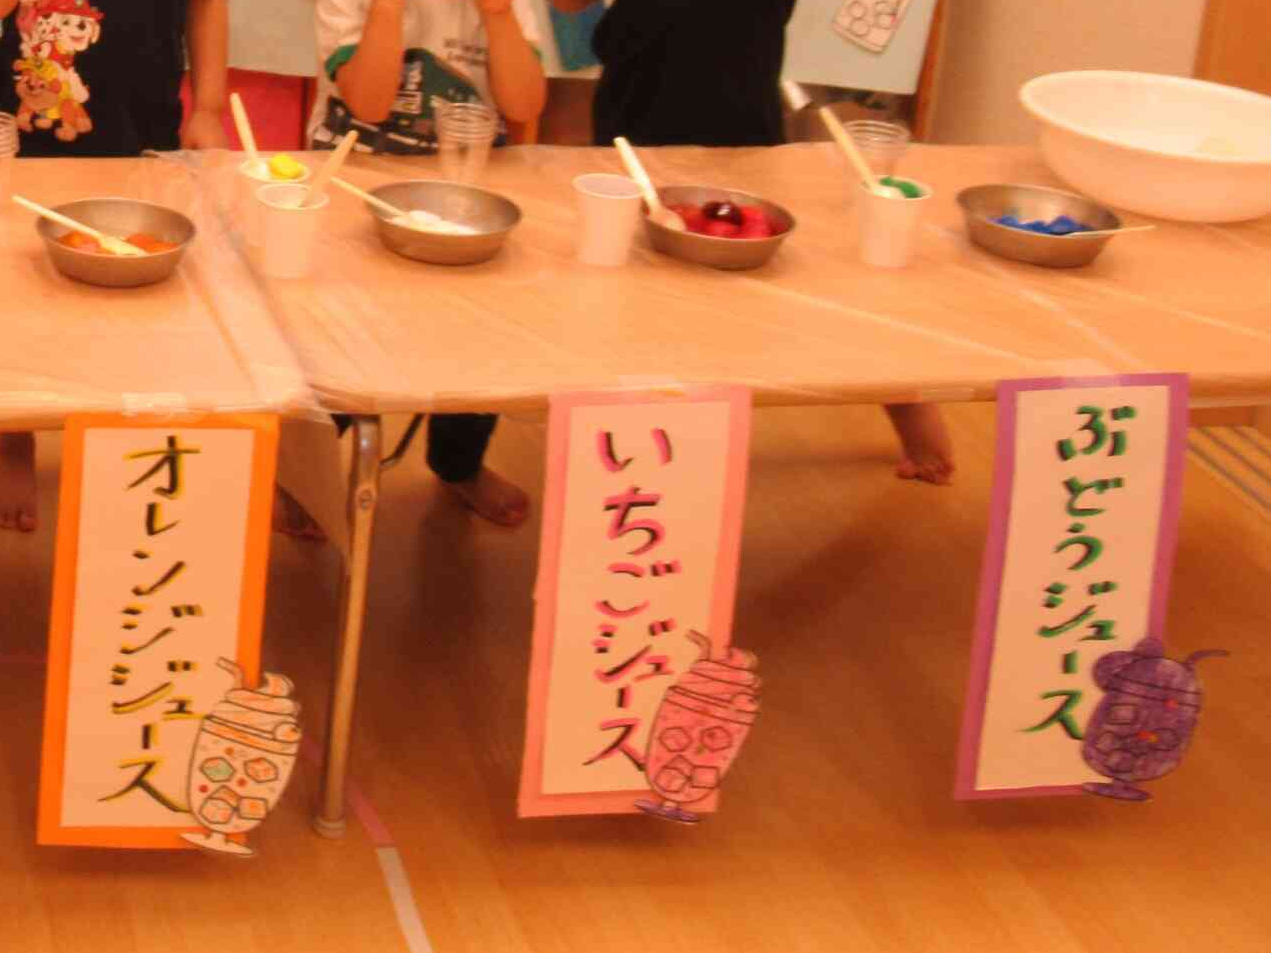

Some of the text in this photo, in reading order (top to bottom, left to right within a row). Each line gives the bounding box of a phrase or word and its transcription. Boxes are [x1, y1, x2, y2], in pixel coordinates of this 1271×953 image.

[97, 434, 204, 814] オレンジジュース
[582, 426, 681, 772] いちごジュース
[1015, 405, 1137, 741] ぶどうジュース
